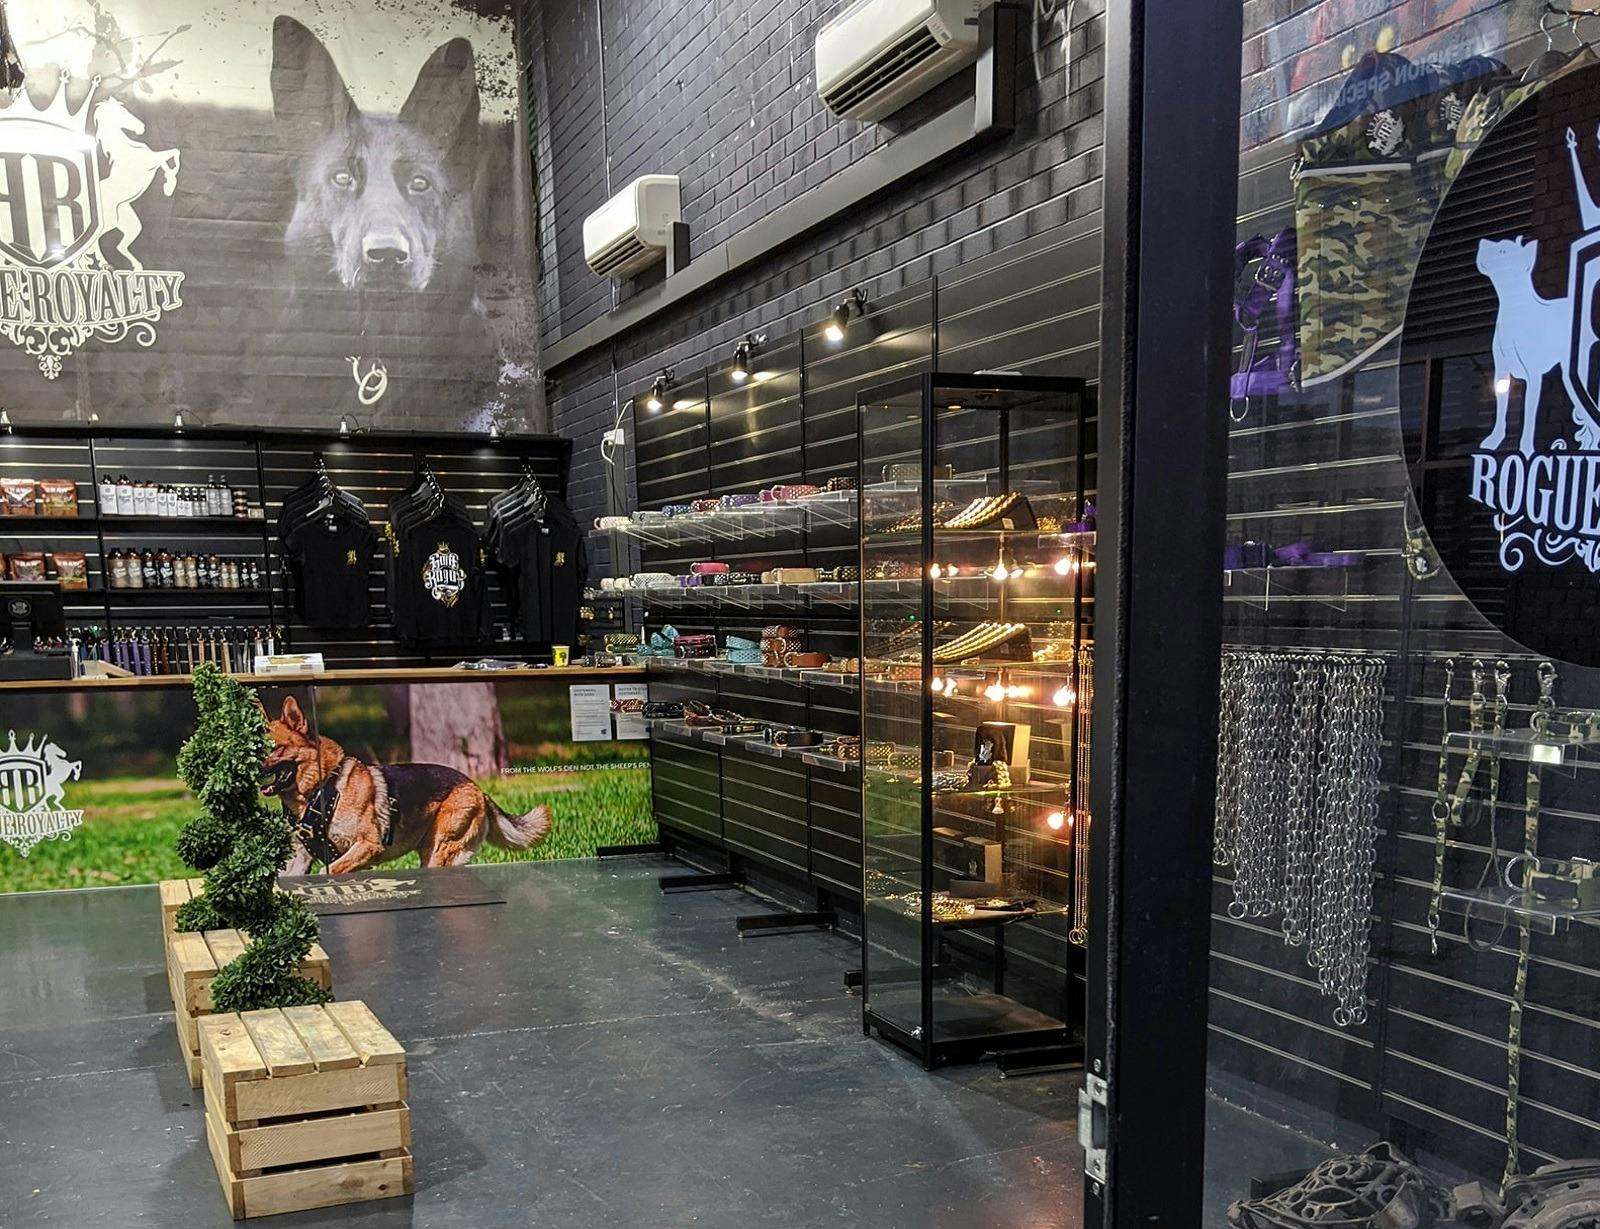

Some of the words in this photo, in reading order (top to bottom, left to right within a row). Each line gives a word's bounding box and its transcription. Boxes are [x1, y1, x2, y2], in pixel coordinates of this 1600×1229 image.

[29, 272, 183, 326] ROYALTY
[1468, 453, 1600, 536] ROGUE
[500, 767, 522, 775] FROM
[537, 765, 563, 773] WOLF'S
[563, 764, 579, 772] DEN
[580, 763, 595, 771] NOT
[18, 811, 82, 836] ROYALTY
